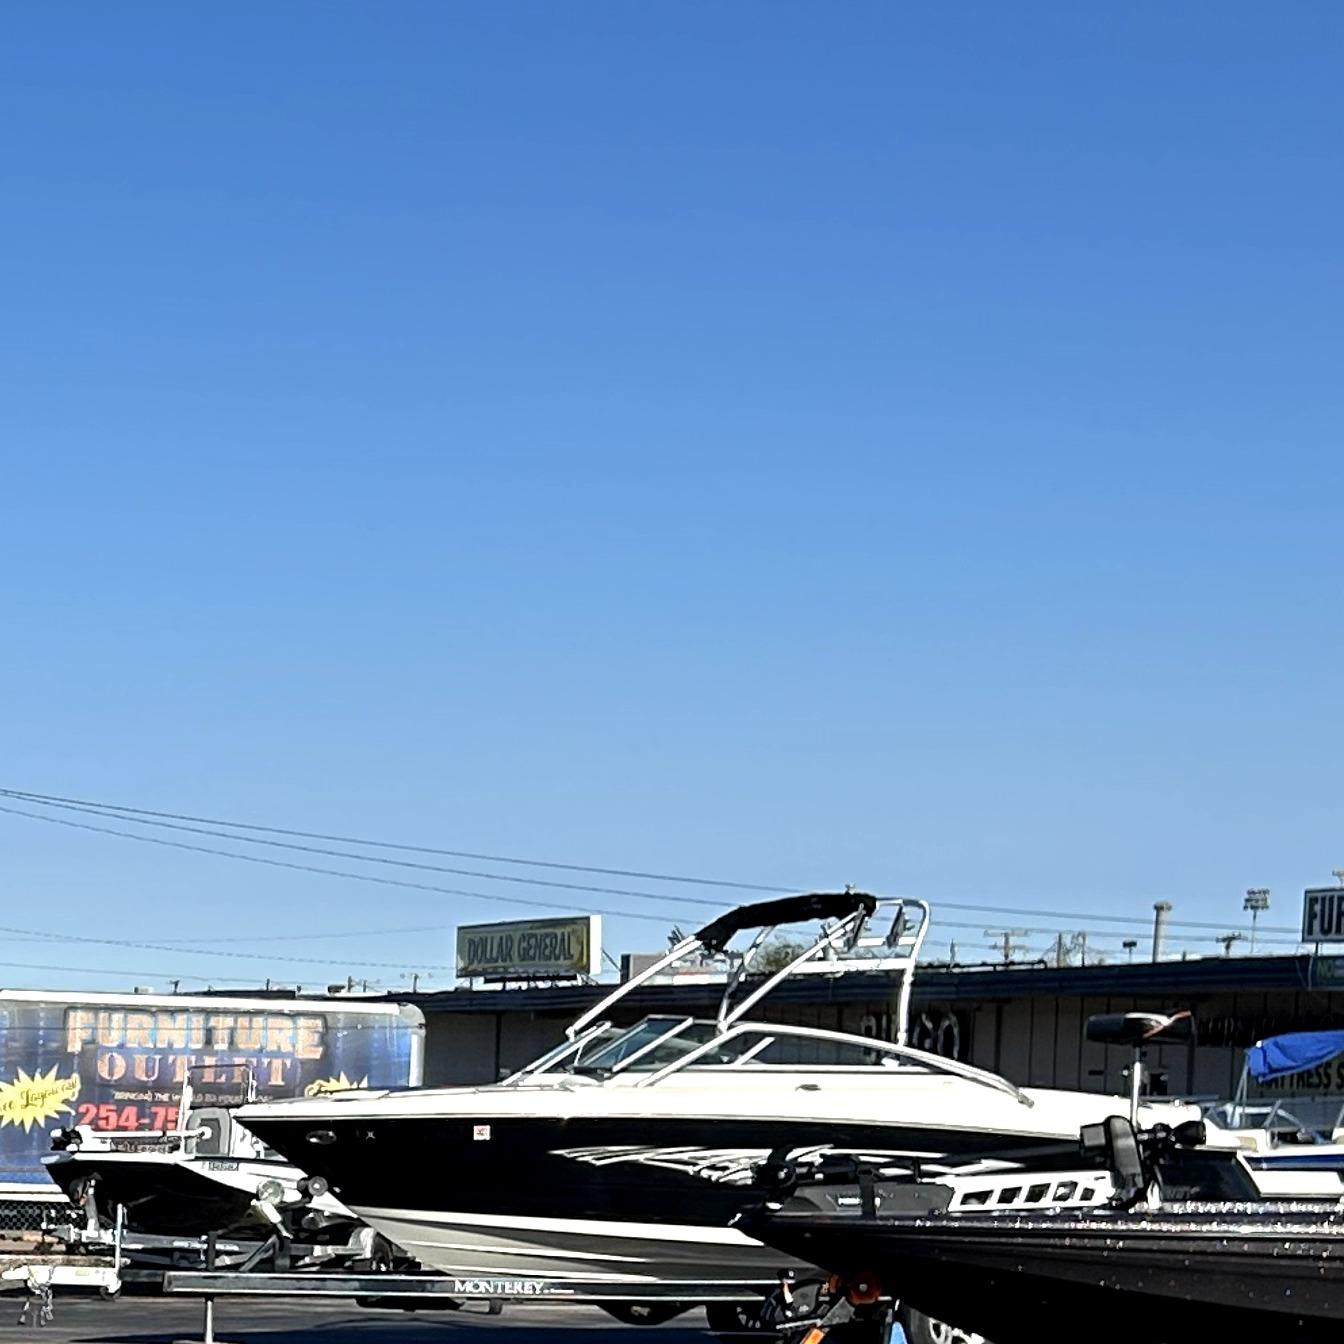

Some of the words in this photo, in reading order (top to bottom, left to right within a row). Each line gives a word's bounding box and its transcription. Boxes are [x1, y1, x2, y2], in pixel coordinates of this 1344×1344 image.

[467, 933, 512, 965] DOLLAR
[517, 930, 574, 962] GENERAL
[66, 1009, 324, 1059] FURNITURE
[96, 1052, 293, 1087] OUTLET
[454, 1279, 544, 1294] MONTEREY
